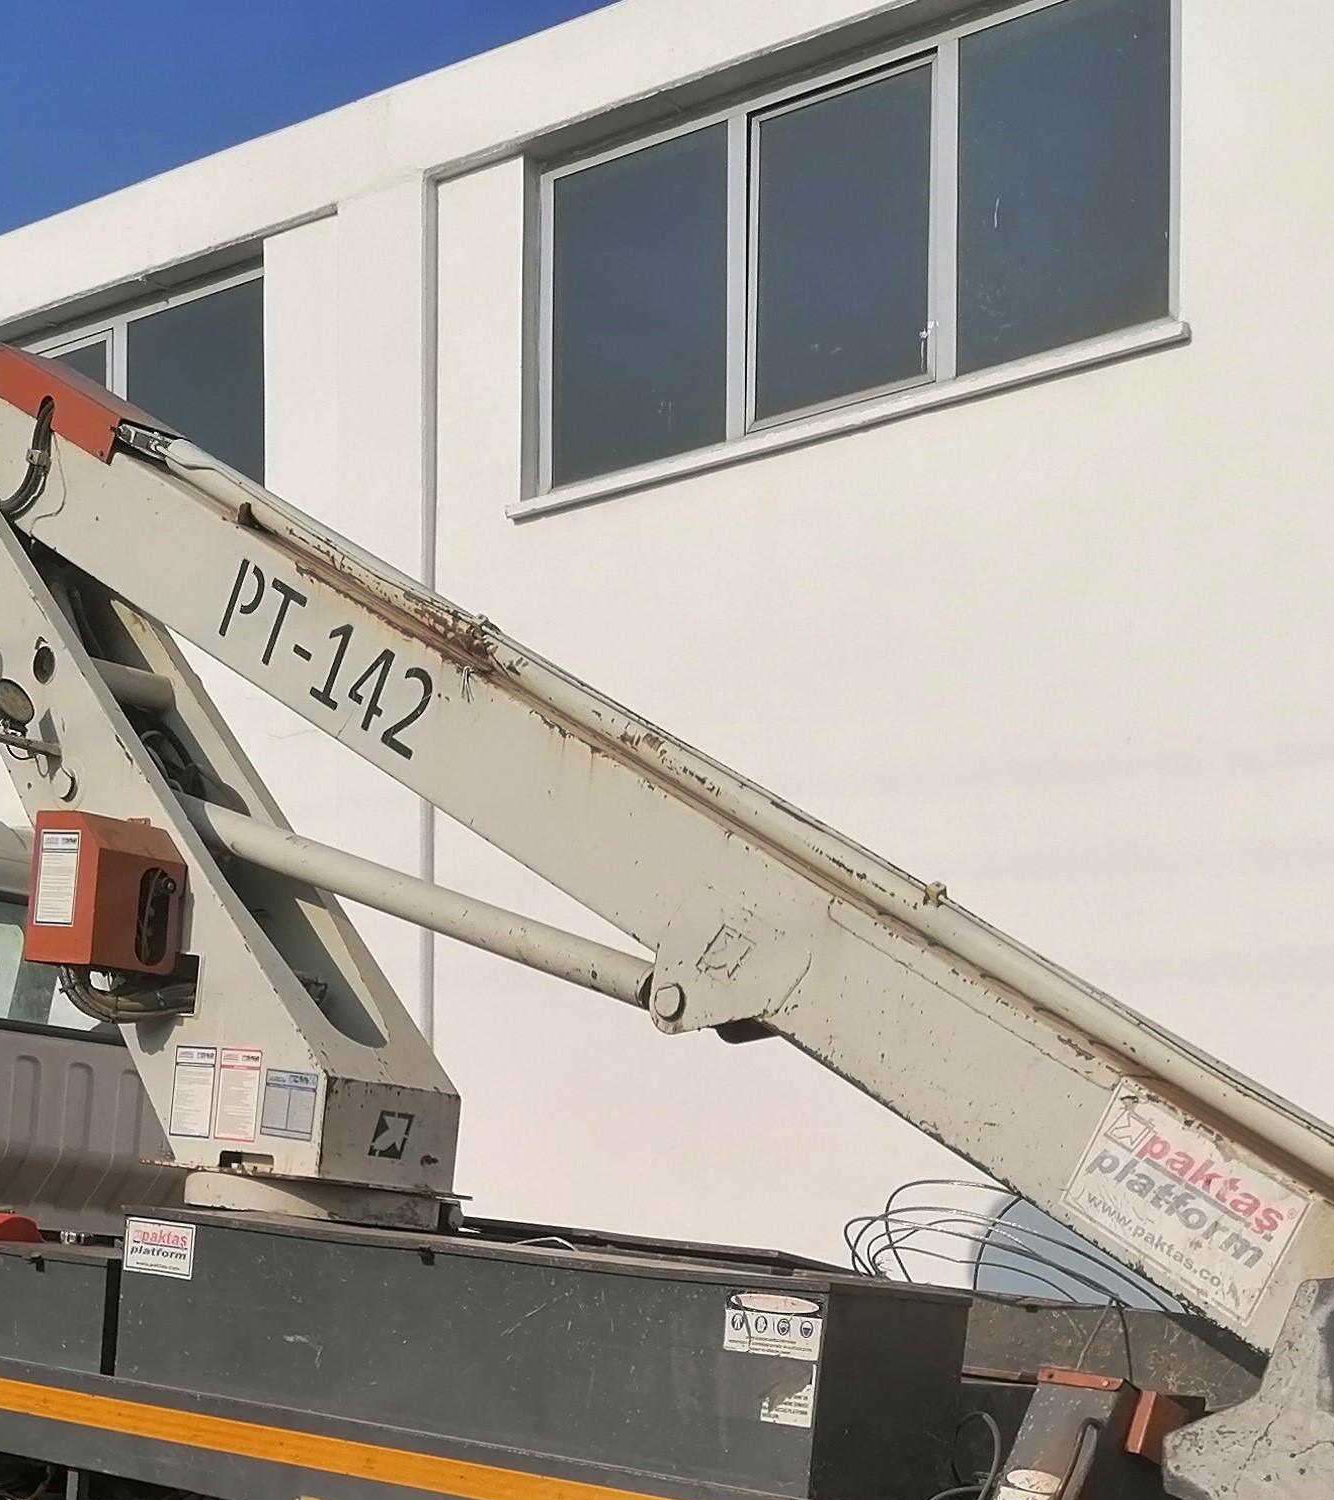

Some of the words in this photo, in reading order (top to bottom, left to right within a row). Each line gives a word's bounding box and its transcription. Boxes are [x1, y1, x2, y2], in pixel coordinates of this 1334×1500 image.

[219, 559, 433, 760] PT-142
[1085, 1149, 1264, 1269] platform
[1134, 1133, 1284, 1240] paktaş
[130, 1245, 186, 1260] platform
[1087, 1192, 1229, 1294] www.paktas.co
